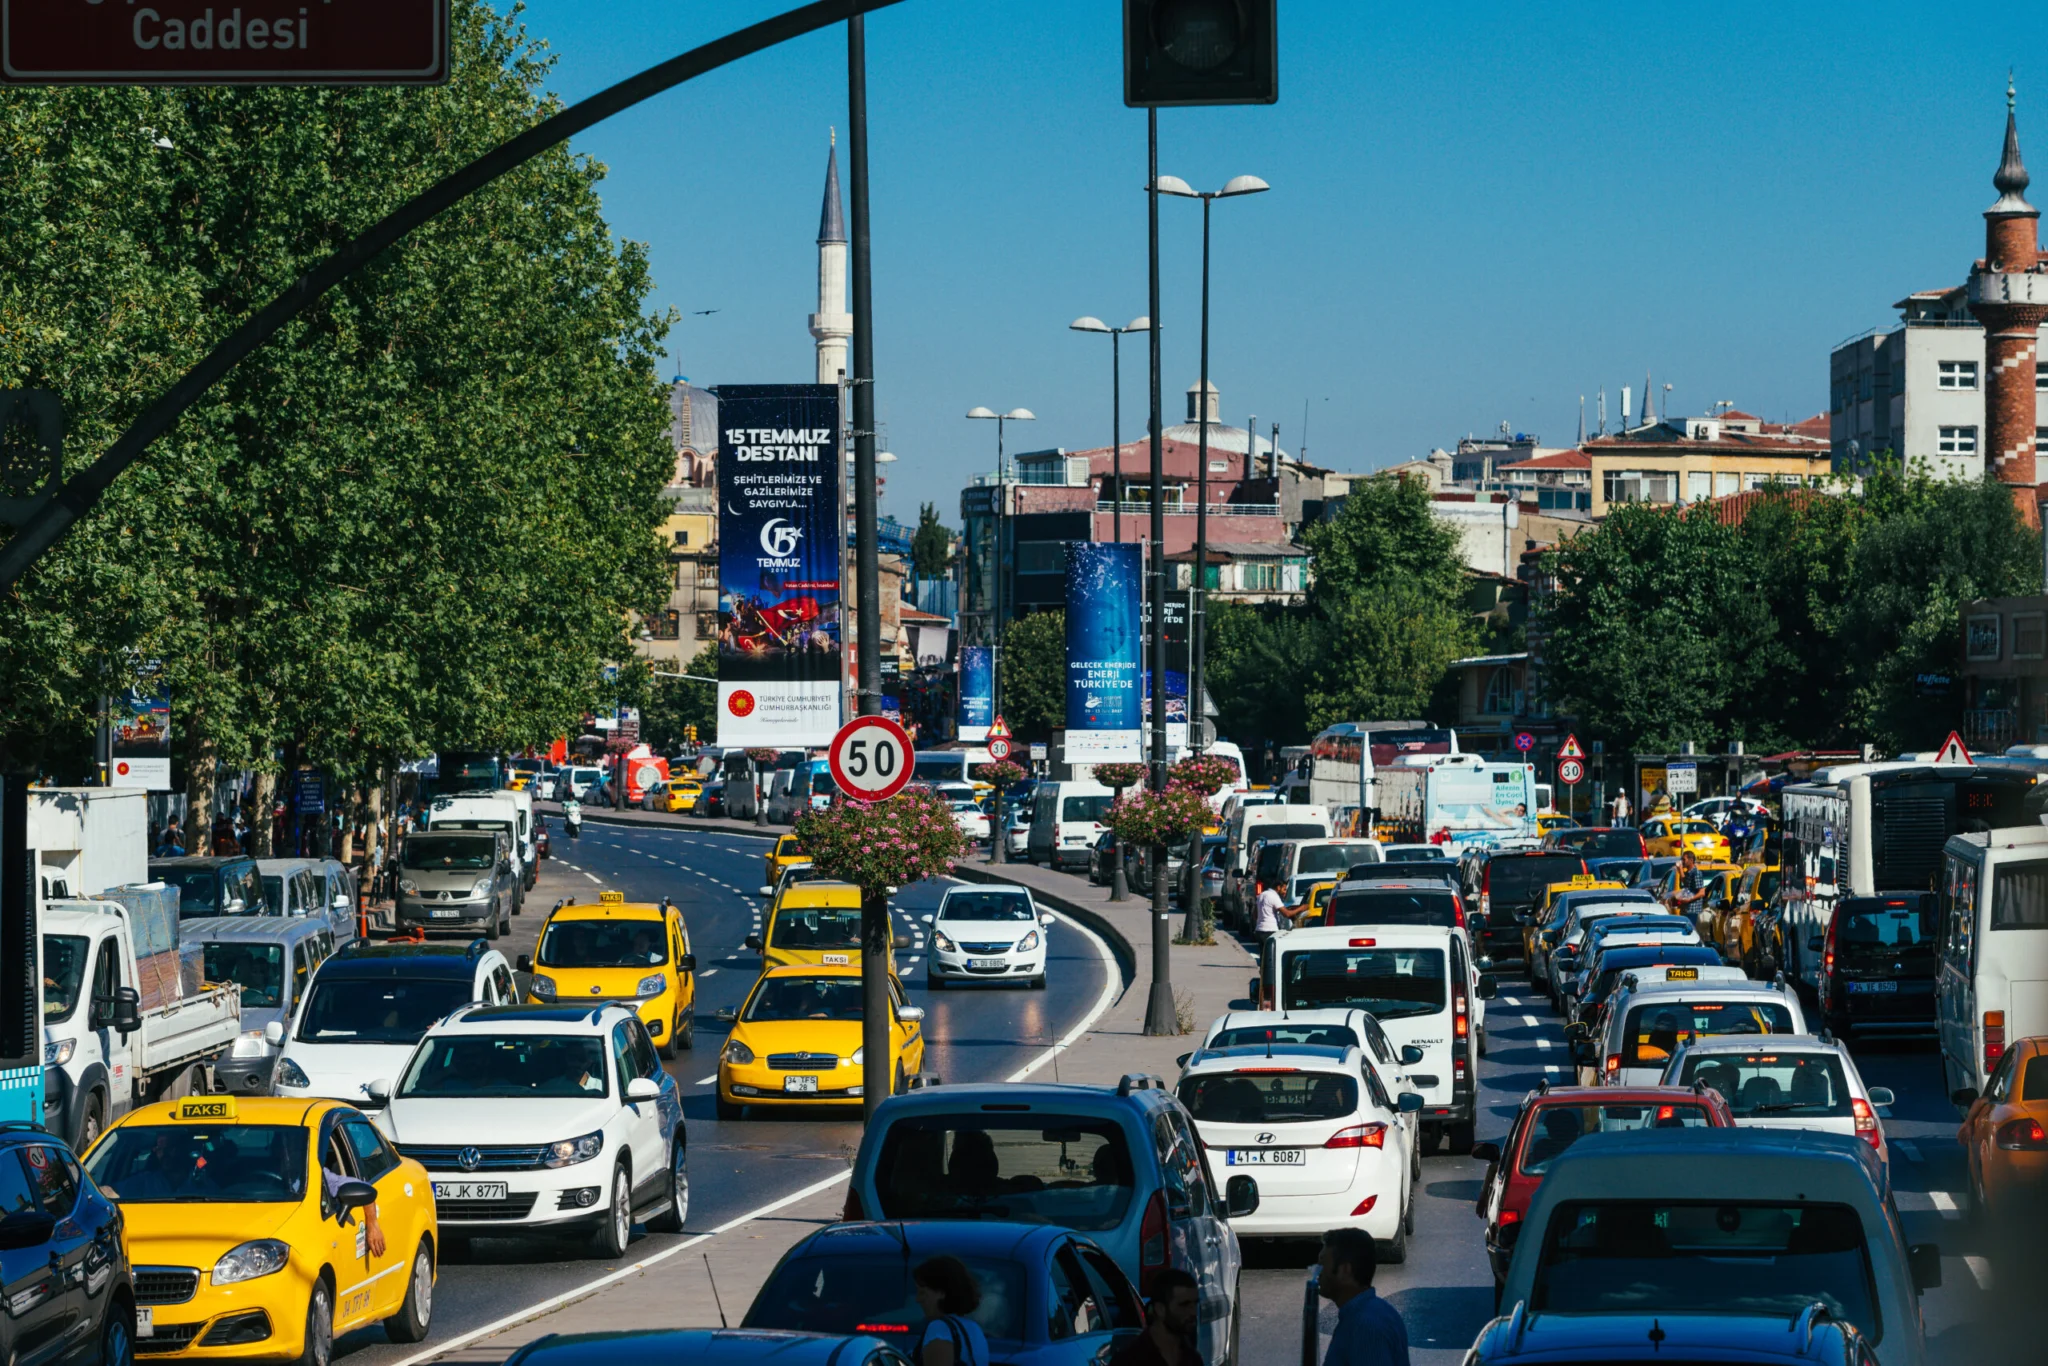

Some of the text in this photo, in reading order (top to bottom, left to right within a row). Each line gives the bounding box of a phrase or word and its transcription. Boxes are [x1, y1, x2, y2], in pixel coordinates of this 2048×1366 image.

[133, 7, 308, 50] Caddesi
[726, 428, 830, 444] 15 TEMMUZ
[737, 445, 818, 461] DESTANI
[734, 474, 822, 486] ŞEHİTLERİMİZE VE
[744, 486, 813, 496] GAZİLERİMİZE
[749, 500, 807, 508] SAYGIYLA...
[756, 558, 801, 568] TEMMUZ
[1088, 669, 1119, 680] ENERJİ
[1074, 678, 1133, 689] TÜRKİYE'DE
[759, 694, 832, 703] TÜRKİYE CUMHURİYETİ
[759, 703, 832, 713] CUMHURBAŞKANLIĞI
[993, 743, 1007, 754] 30
[848, 740, 895, 778] 50
[1564, 765, 1579, 777] 30
[788, 1076, 797, 1084] 34
[1237, 1150, 1301, 1162] 41 K 6087
[436, 1184, 504, 1198] 34 JK 8771
